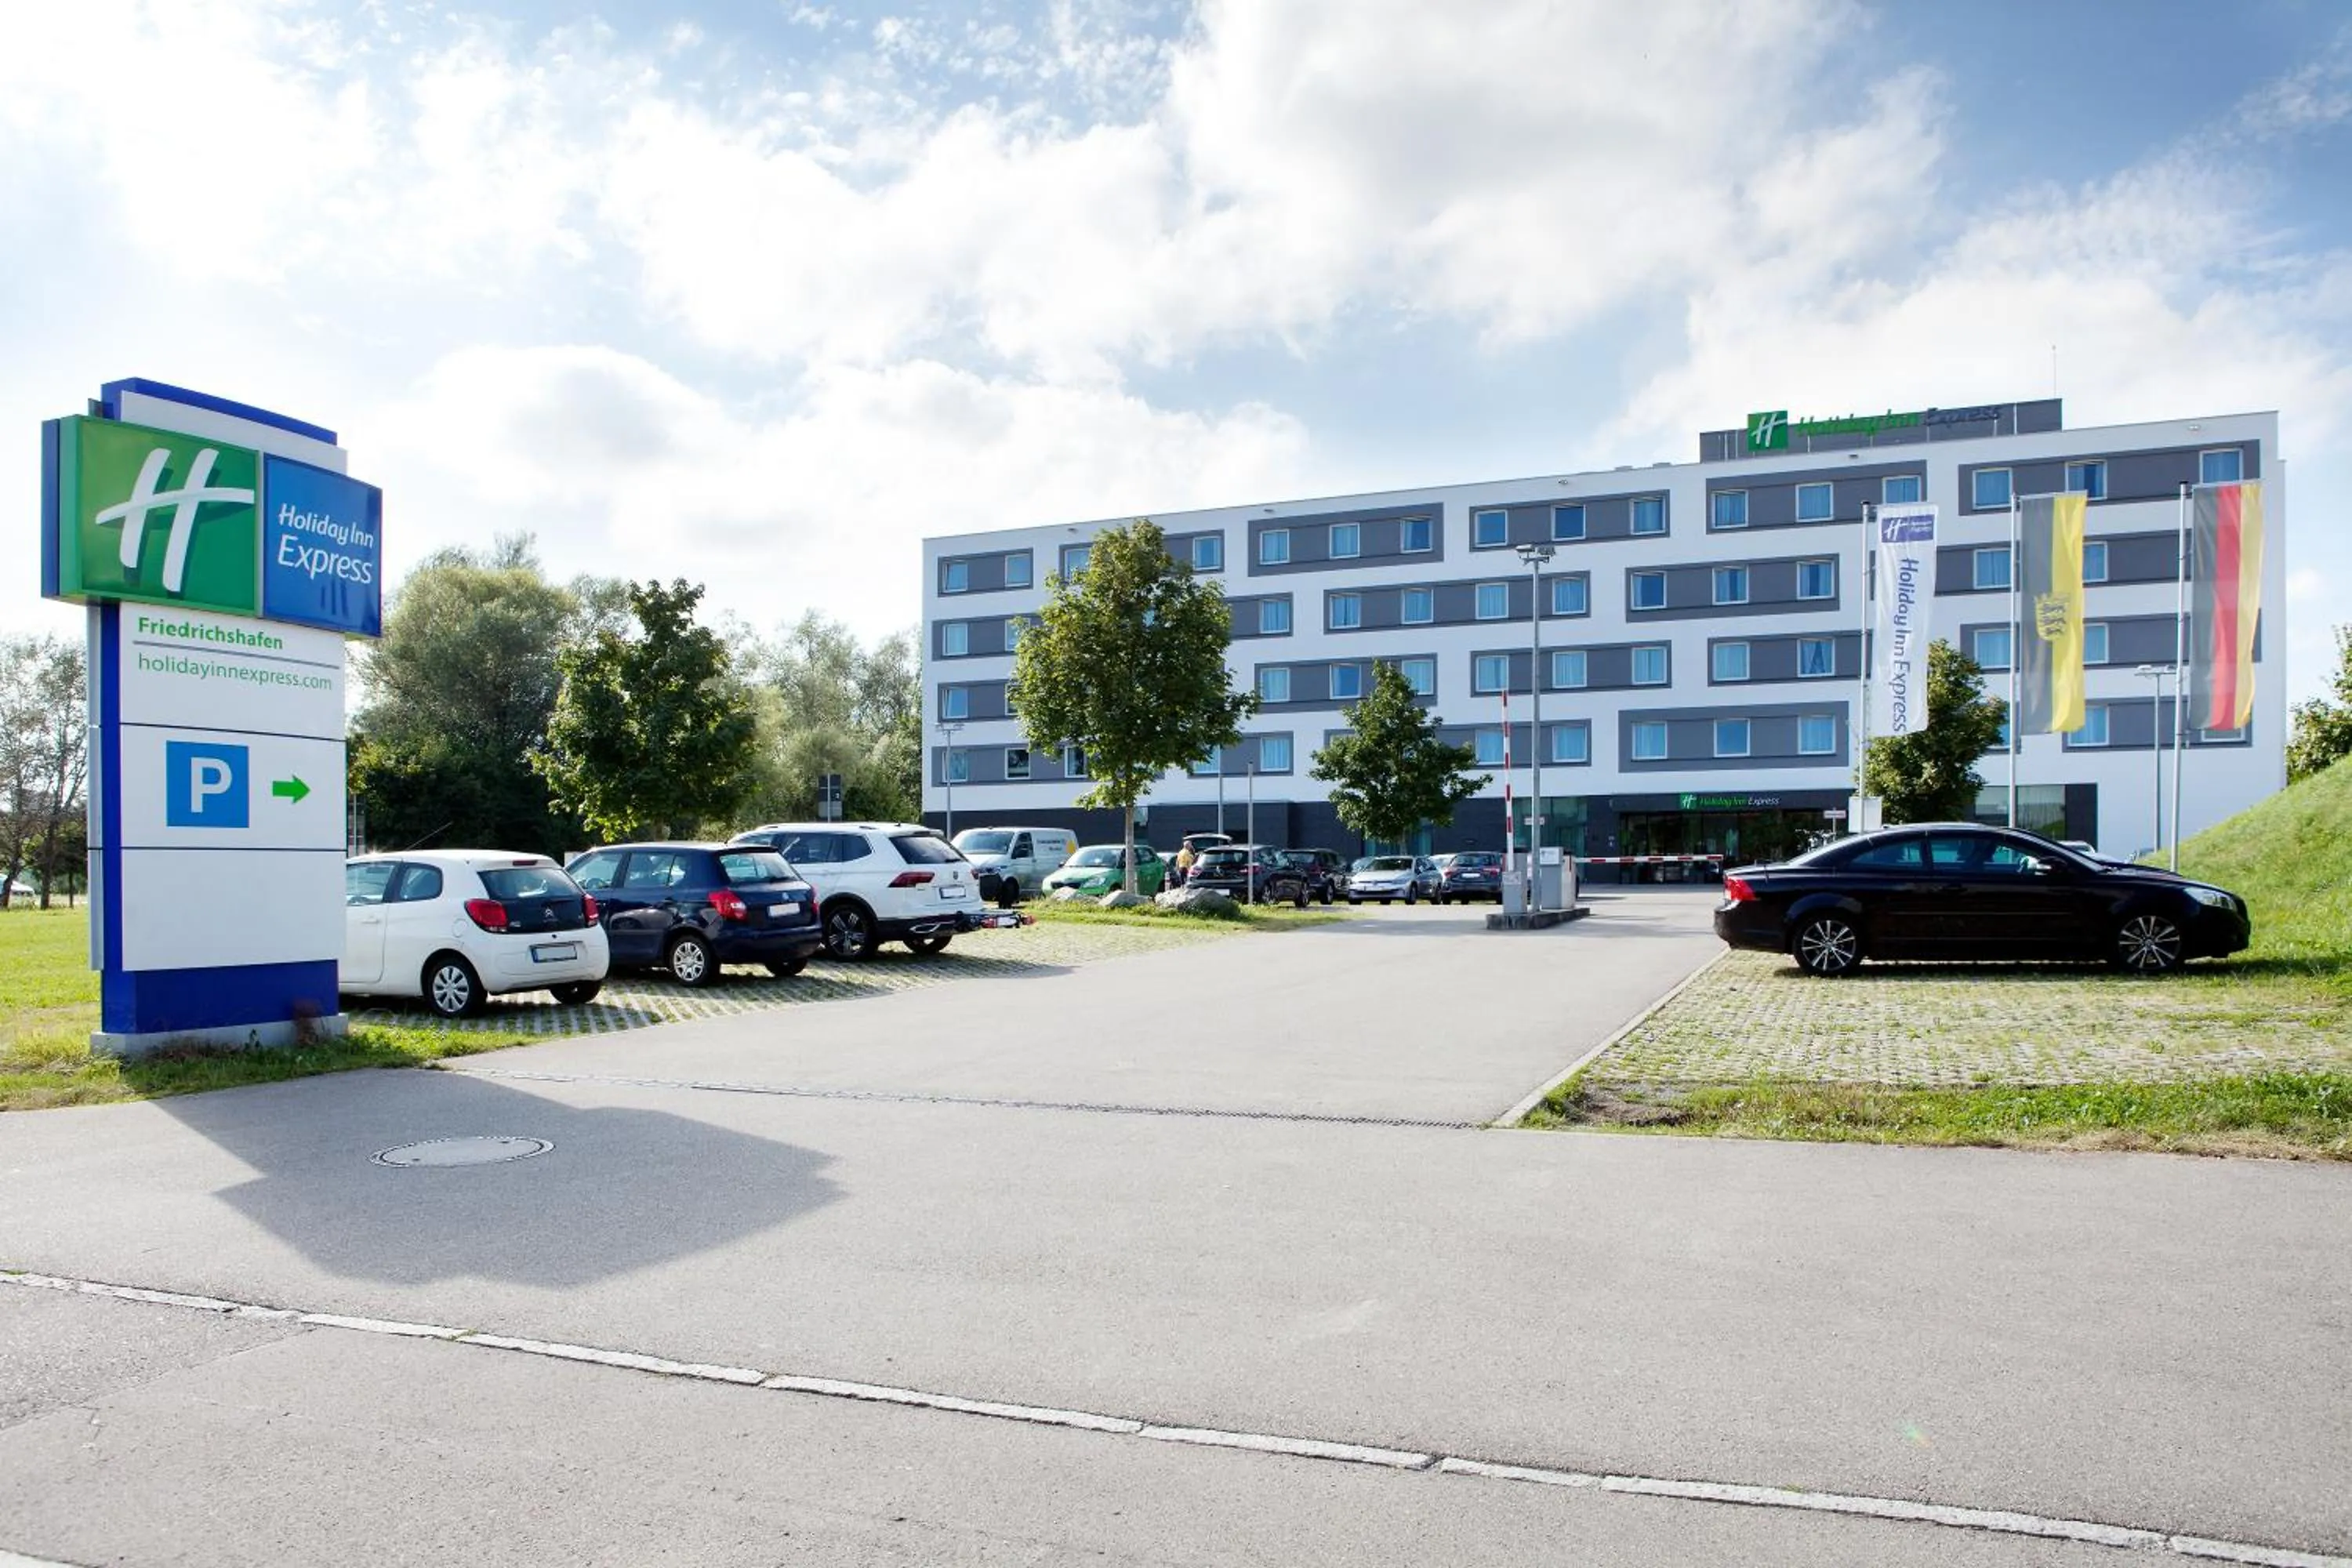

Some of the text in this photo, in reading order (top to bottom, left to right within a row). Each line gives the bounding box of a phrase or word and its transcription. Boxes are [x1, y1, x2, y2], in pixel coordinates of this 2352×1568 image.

[278, 503, 374, 549] Holiday Inn
[278, 533, 372, 584] Express
[138, 617, 283, 650] Friedrichshafen
[1888, 557, 1919, 732] Holiday Inn Express
[138, 652, 332, 690] holidayinnexpress.com
[191, 757, 233, 813] P
